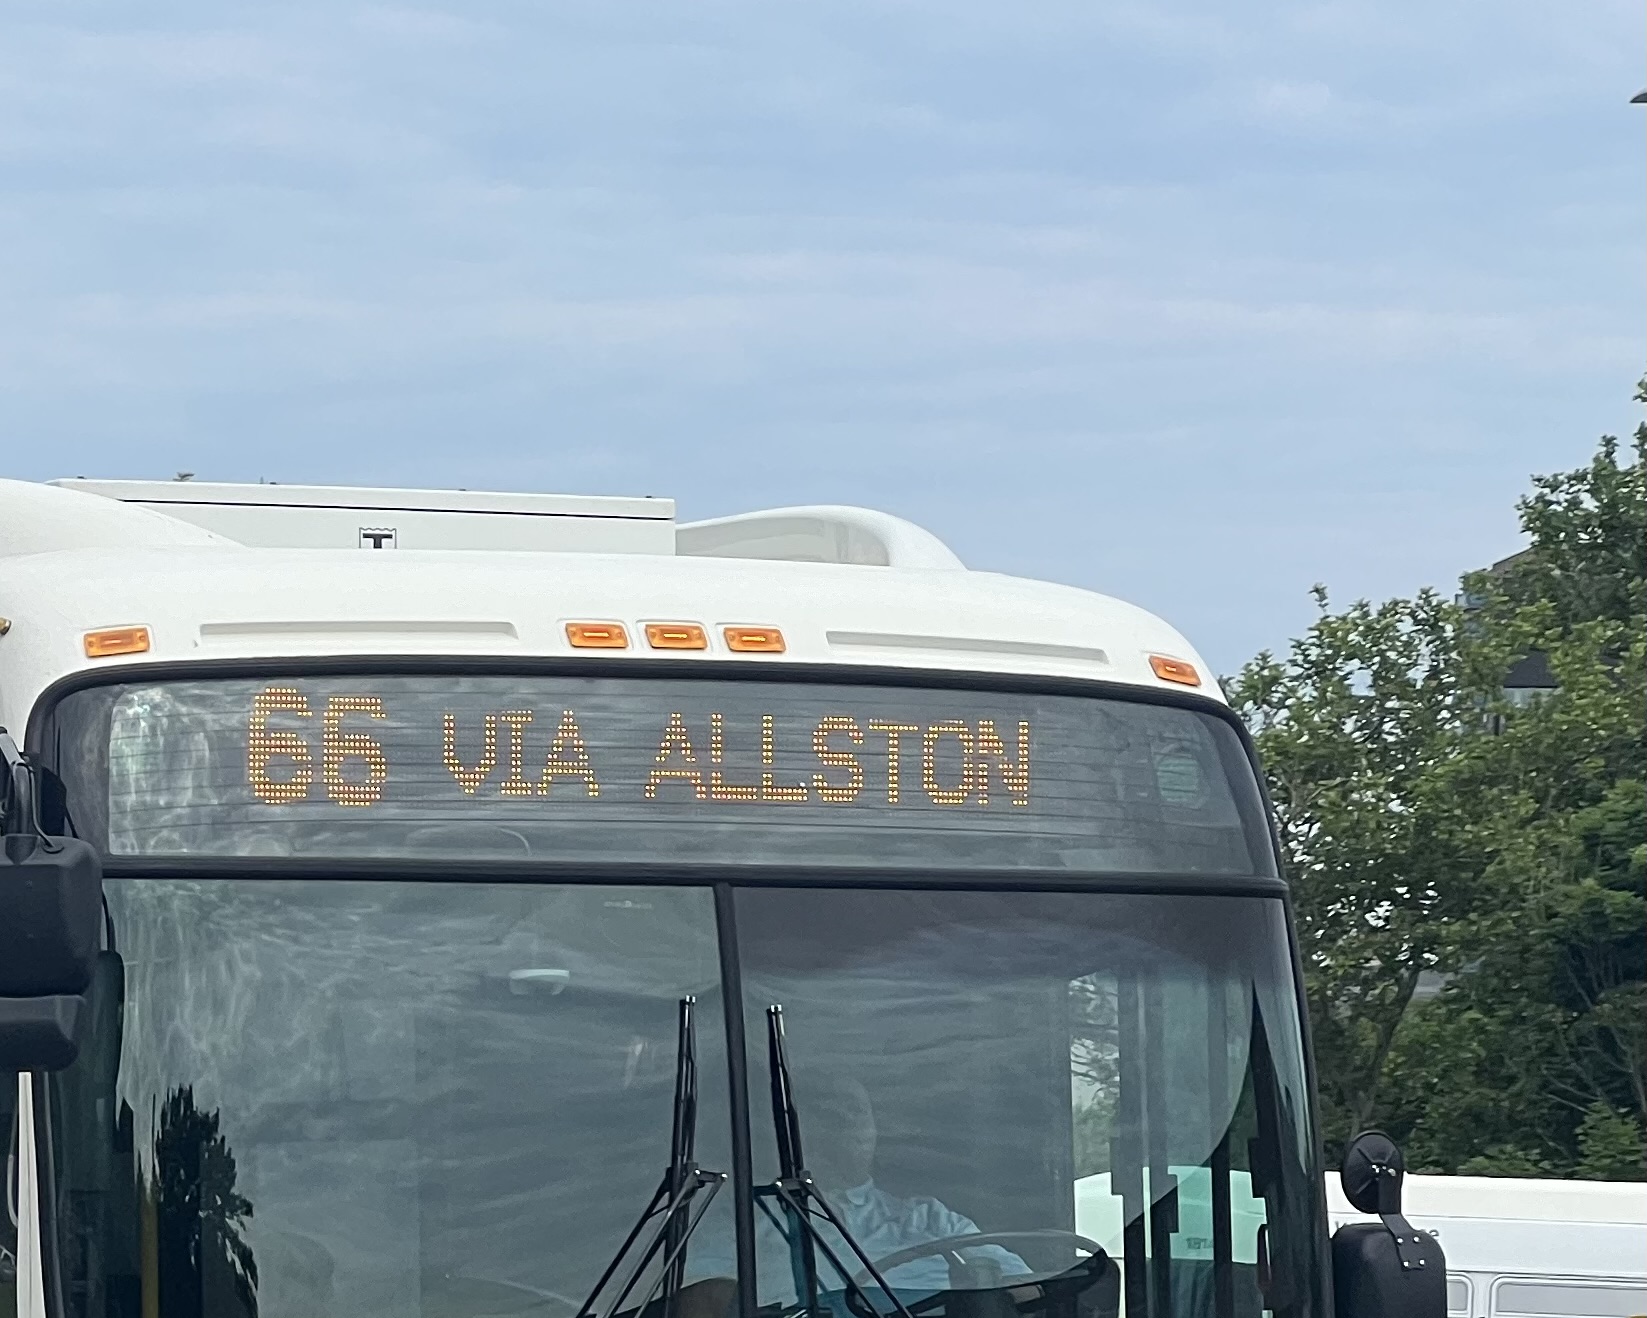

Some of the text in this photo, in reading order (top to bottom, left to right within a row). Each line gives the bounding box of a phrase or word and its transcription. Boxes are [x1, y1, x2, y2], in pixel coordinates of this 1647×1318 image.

[246, 686, 1030, 808] 66 VIA ALLSTON
